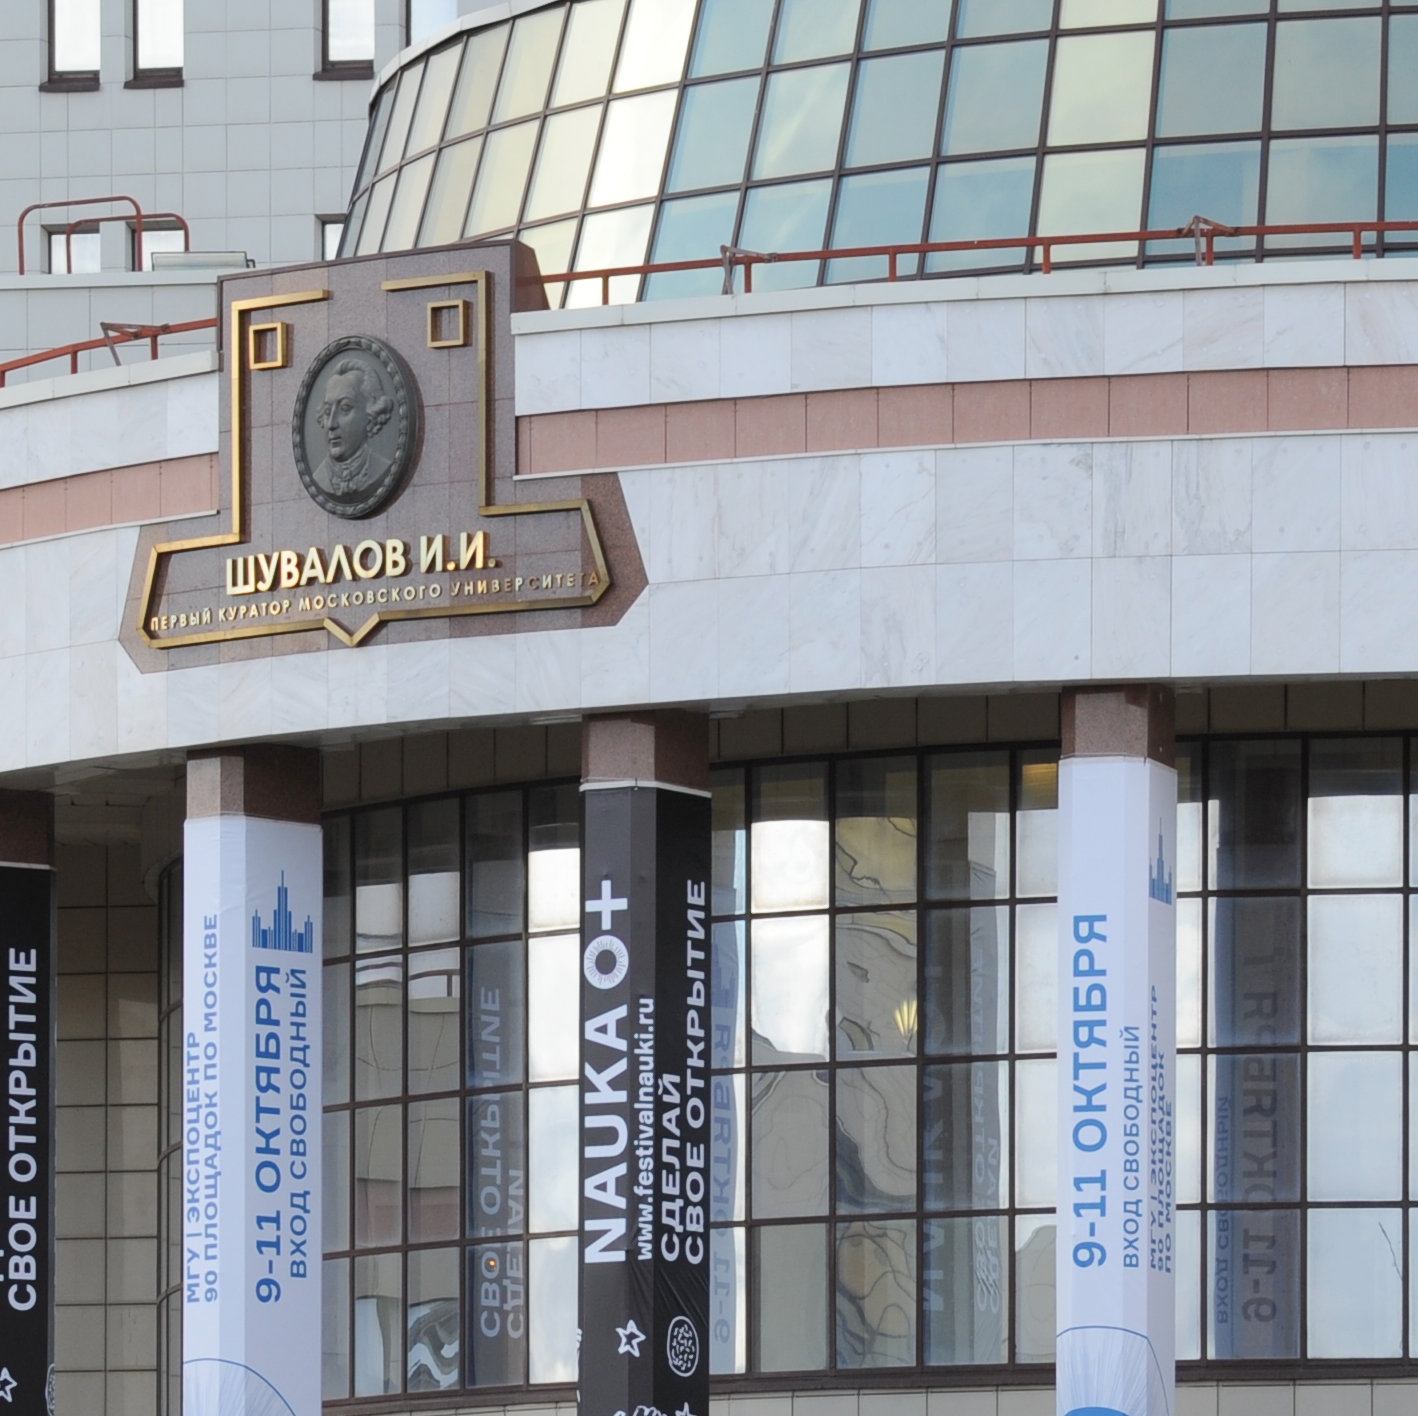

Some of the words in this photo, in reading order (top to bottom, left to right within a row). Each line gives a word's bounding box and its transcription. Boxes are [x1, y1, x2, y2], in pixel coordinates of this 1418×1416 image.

[150, 606, 212, 631] ПЕРВЫЙ
[218, 598, 291, 622] КУРАТОР
[298, 582, 442, 612] МОСКОВСКОГО
[450, 570, 600, 598] УНИВЕРСИТЕТА
[226, 538, 406, 596] ШУВАЛОВ
[418, 530, 497, 572] И.И.
[204, 914, 218, 1032] МОСКВЕ
[686, 879, 706, 1129] ОТКРЫТИЕ
[1073, 914, 1108, 1152] ОКТЯБРЯ
[8, 948, 37, 1183] ОТКРЫТИЕ
[204, 1042, 218, 1082] ПО
[255, 964, 281, 1194] ОКТЯБРЯ
[285, 968, 310, 1181] СВОБОДНЫЙ
[1119, 1025, 1142, 1188] СВОБОДНЫЙ
[186, 1032, 201, 1224] ЭКСПОЦЕНТР
[204, 1090, 222, 1266] ПЛОЩАДОК
[584, 1004, 628, 1264] NAUKA
[633, 997, 655, 1260] www.festivalnauki.ru
[659, 1073, 685, 1262] СДЕЛАЙ
[8, 1195, 37, 1311] СВОЕ
[255, 1209, 281, 1303] 9-11
[289, 1190, 310, 1279] ВХОД
[686, 1143, 705, 1265] СВОЕ
[1073, 1169, 1107, 1268] 9-11
[1123, 1198, 1142, 1268] ВХОД
[186, 1247, 201, 1303] МГУ
[204, 1276, 218, 1303] 90
